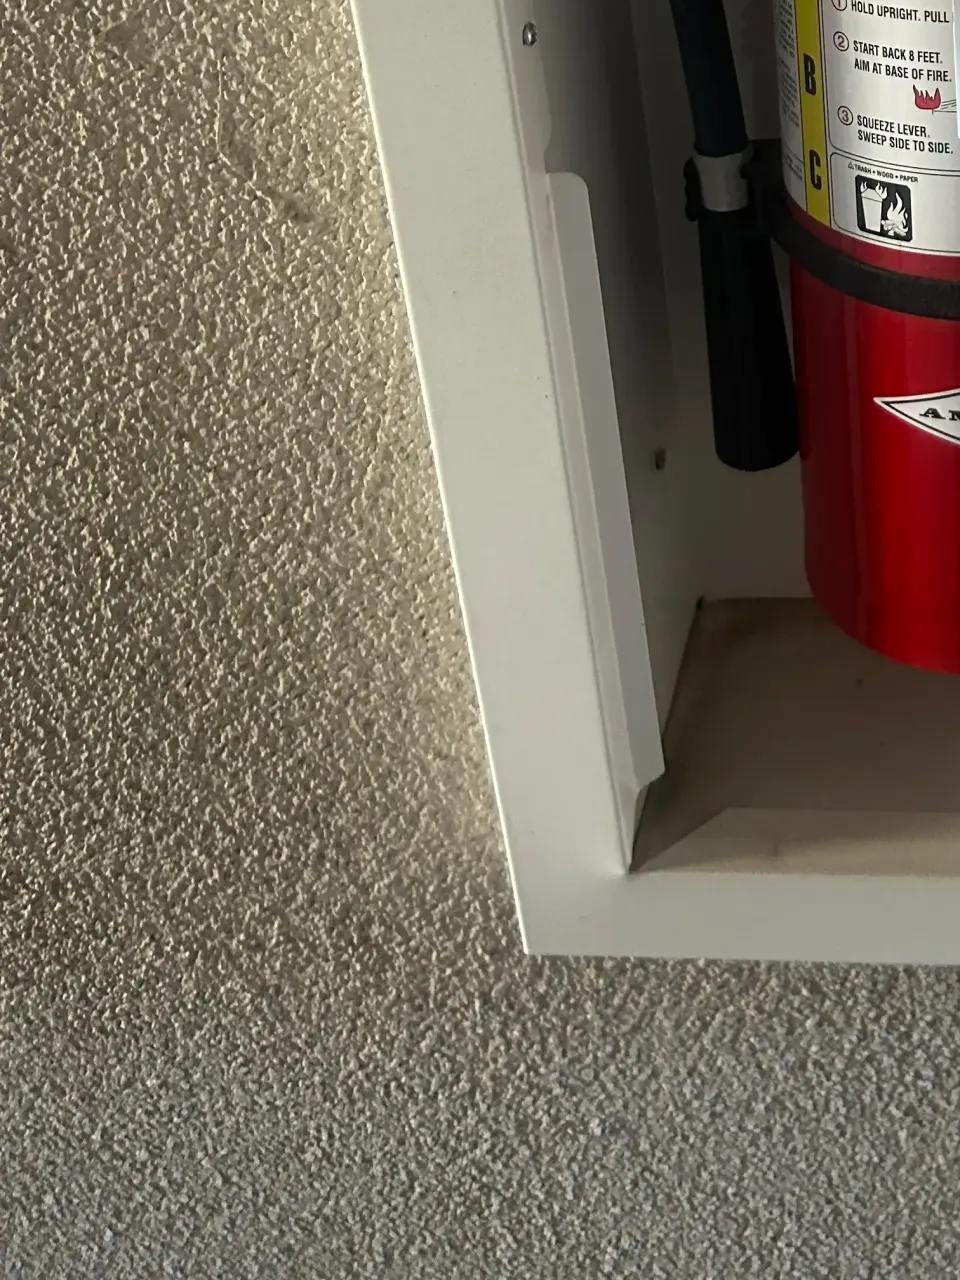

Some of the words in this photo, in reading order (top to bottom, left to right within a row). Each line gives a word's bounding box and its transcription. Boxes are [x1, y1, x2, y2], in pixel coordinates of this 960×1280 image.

[851, 0, 874, 15] HOLD
[876, 5, 921, 21] UPRIGHT.
[924, 10, 950, 23] PULL
[853, 40, 880, 57] START
[882, 46, 907, 61] BACK
[908, 51, 915, 62] 8
[917, 51, 943, 64] FEET.
[803, 52, 817, 97] B
[854, 58, 870, 72] AIM
[872, 62, 883, 75] AT
[885, 65, 909, 79] BASE
[911, 68, 924, 81] OF
[926, 70, 952, 83] FIRE.
[857, 114, 895, 134] SQUEEZE
[897, 123, 930, 138] LEVER.
[857, 130, 886, 146] SWEEP
[889, 137, 911, 151] SIDE
[913, 140, 925, 152] TO
[927, 142, 954, 155] SIDE.
[809, 148, 822, 192] C
[876, 170, 894, 179] WOOD
[899, 175, 919, 183] PAPER
